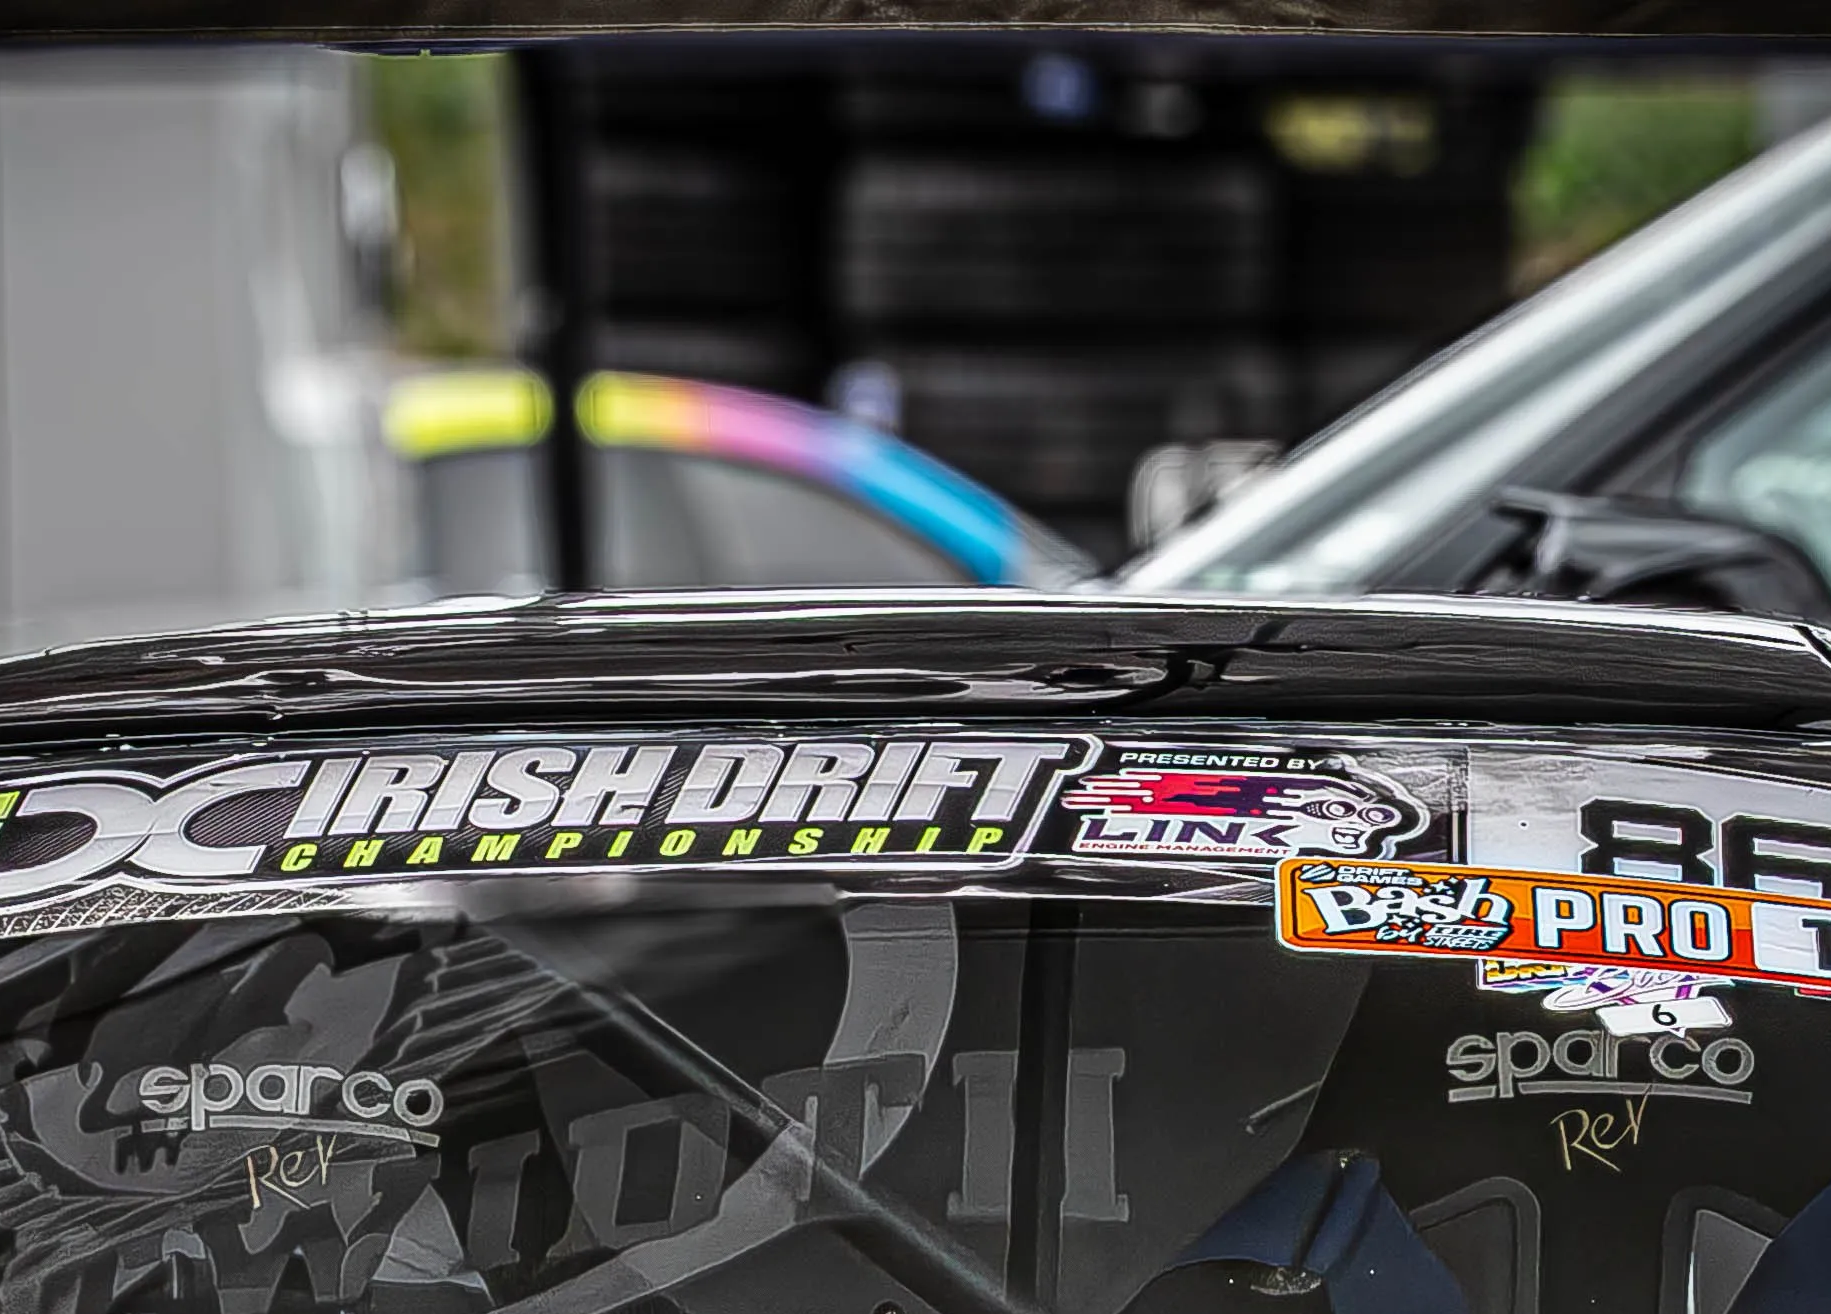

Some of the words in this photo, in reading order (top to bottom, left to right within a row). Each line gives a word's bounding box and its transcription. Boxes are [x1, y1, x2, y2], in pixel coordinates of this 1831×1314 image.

[1120, 751, 1279, 769] PRESENTED
[1286, 757, 1325, 771] BY
[282, 743, 677, 838] IRISH
[665, 742, 1069, 823] DRIFT
[1081, 816, 1302, 848] LINK
[280, 827, 1005, 872] CHAMPIONSHIP
[1078, 842, 1151, 851] ENGINE
[1156, 843, 1293, 857] MANAGEMENT
[1336, 873, 1423, 886] GAMES
[1337, 866, 1411, 877] DRIFT
[1303, 876, 1512, 935] Bash
[1376, 925, 1423, 942] by
[1532, 886, 1730, 962] PRO
[1422, 934, 1494, 950] STREETS
[1651, 1003, 1678, 1026] 6
[1446, 1030, 1755, 1098] sparco
[139, 1063, 444, 1131] sparco
